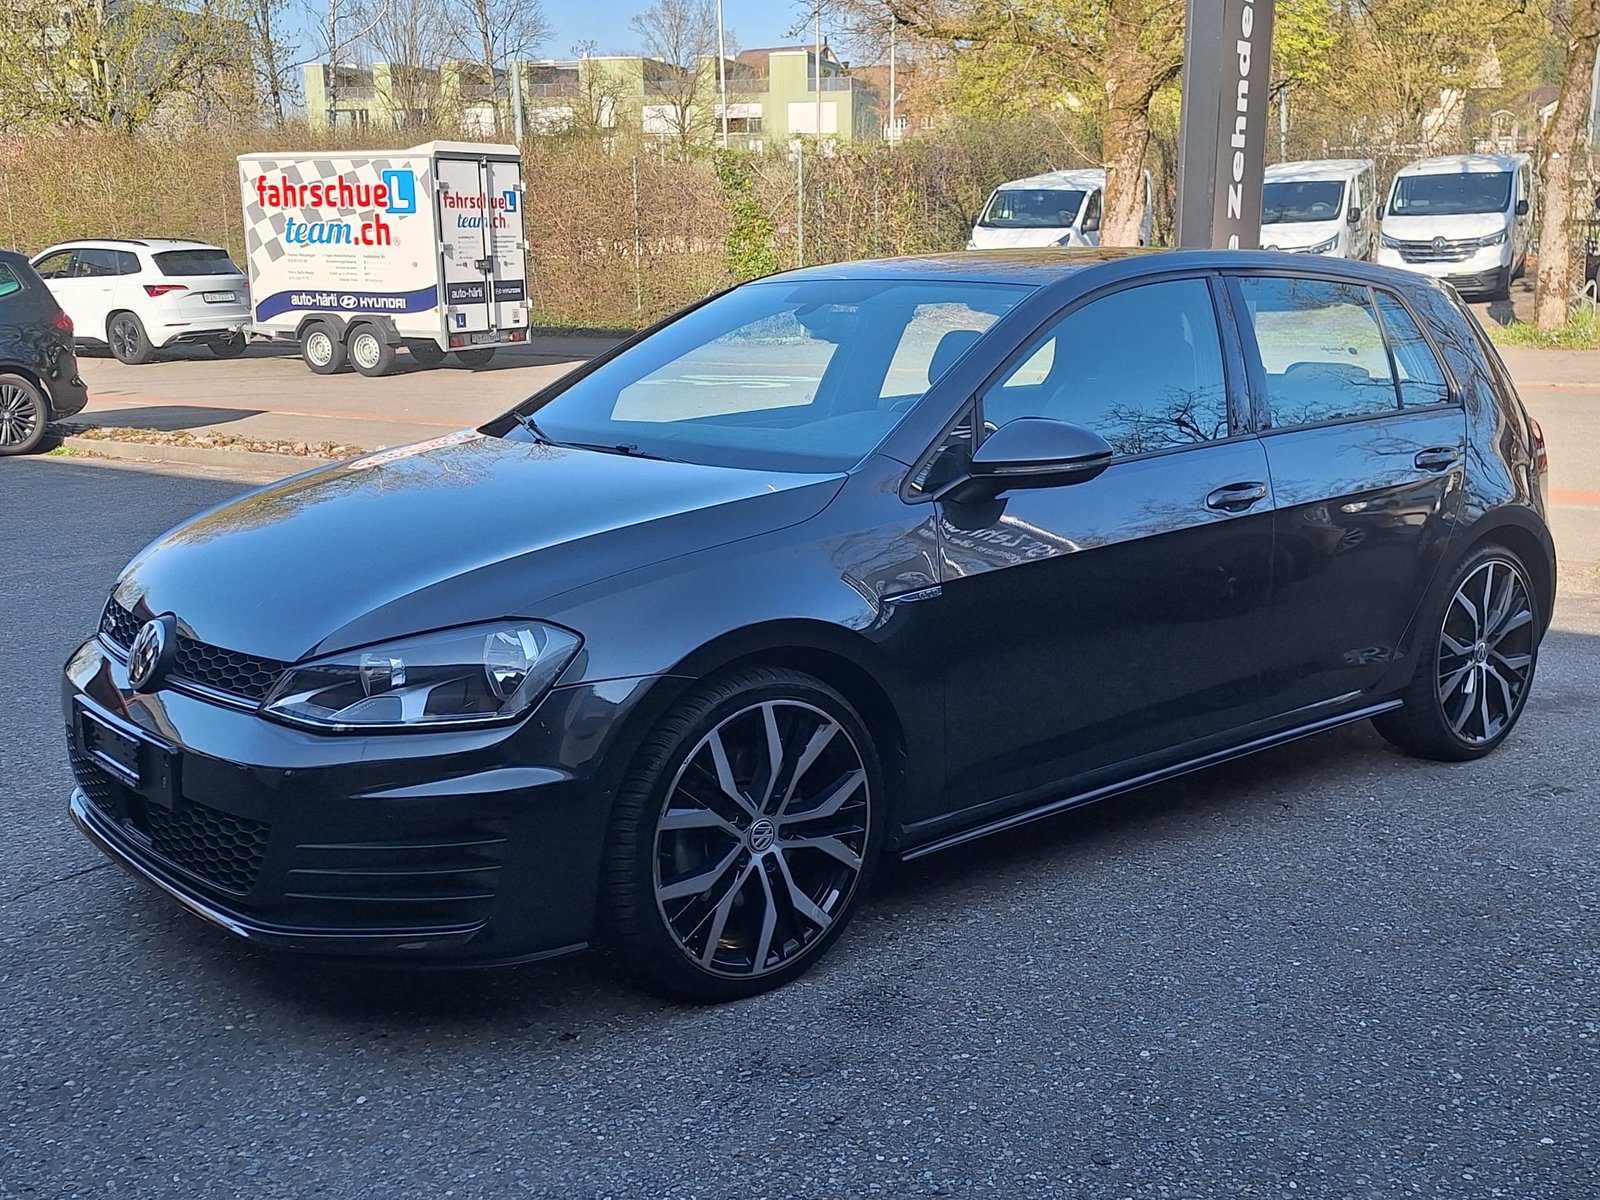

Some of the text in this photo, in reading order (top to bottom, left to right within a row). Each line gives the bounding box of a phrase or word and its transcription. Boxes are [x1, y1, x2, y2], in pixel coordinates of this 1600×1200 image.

[1228, 0, 1254, 219] Zehnde
[286, 213, 391, 245] team.ch
[291, 292, 406, 309] auto-härti HYUNDAI
